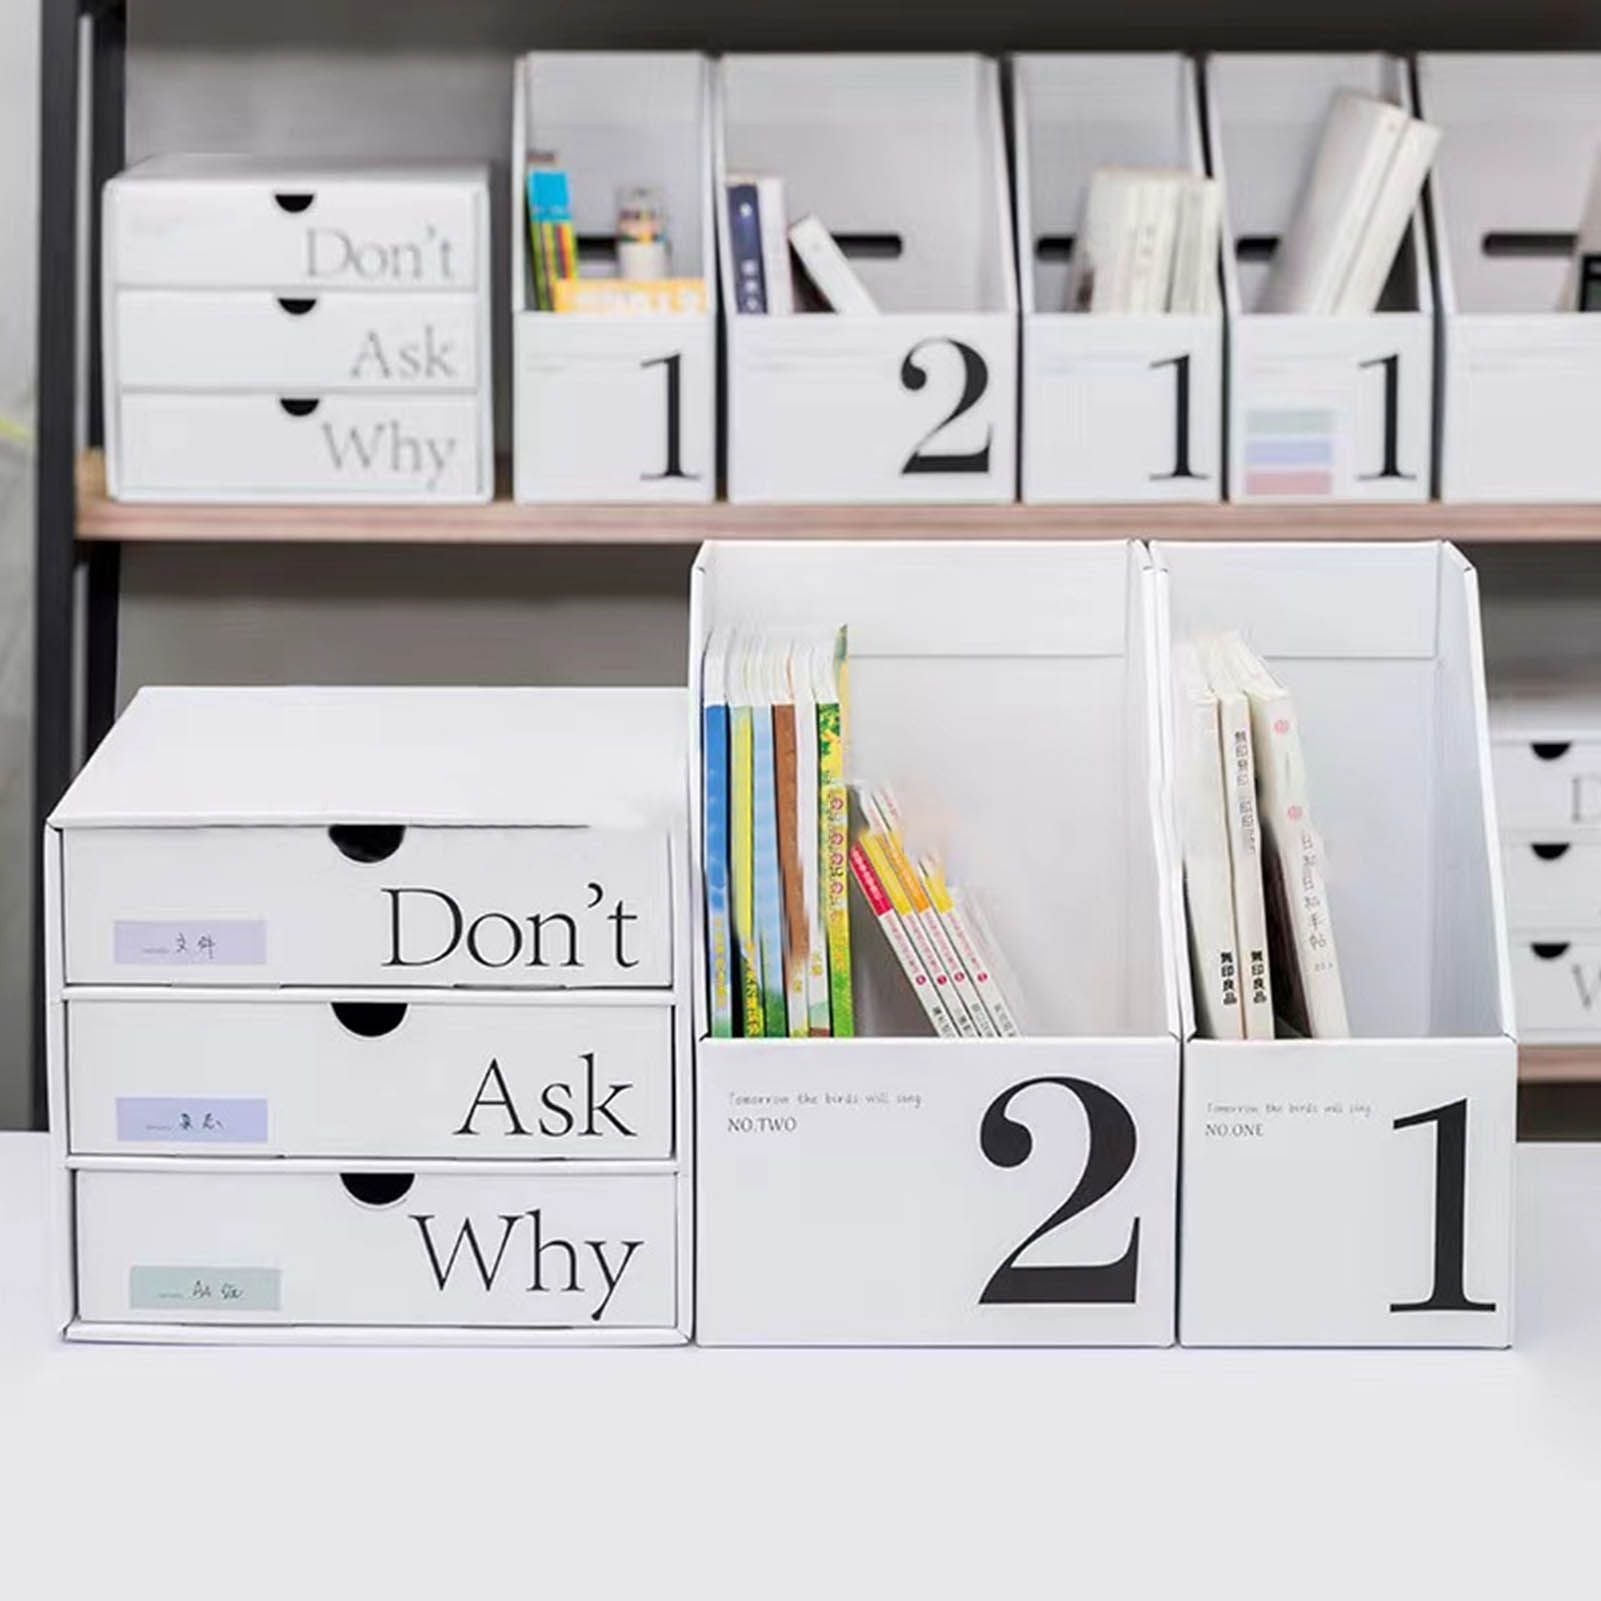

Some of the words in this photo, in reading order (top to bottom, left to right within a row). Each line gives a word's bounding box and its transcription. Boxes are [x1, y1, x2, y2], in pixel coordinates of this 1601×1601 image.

[305, 224, 456, 281] Don't
[349, 325, 457, 380] Ask
[899, 338, 993, 476] 2
[320, 420, 458, 491] Why
[641, 352, 701, 480] 1
[1149, 352, 1210, 480] 1
[1357, 352, 1417, 480] 1
[381, 882, 640, 970] Don't
[452, 1053, 637, 1137] Ask
[978, 1076, 1141, 1305] 2
[1390, 1098, 1497, 1313] 1
[408, 1210, 644, 1320] Why
